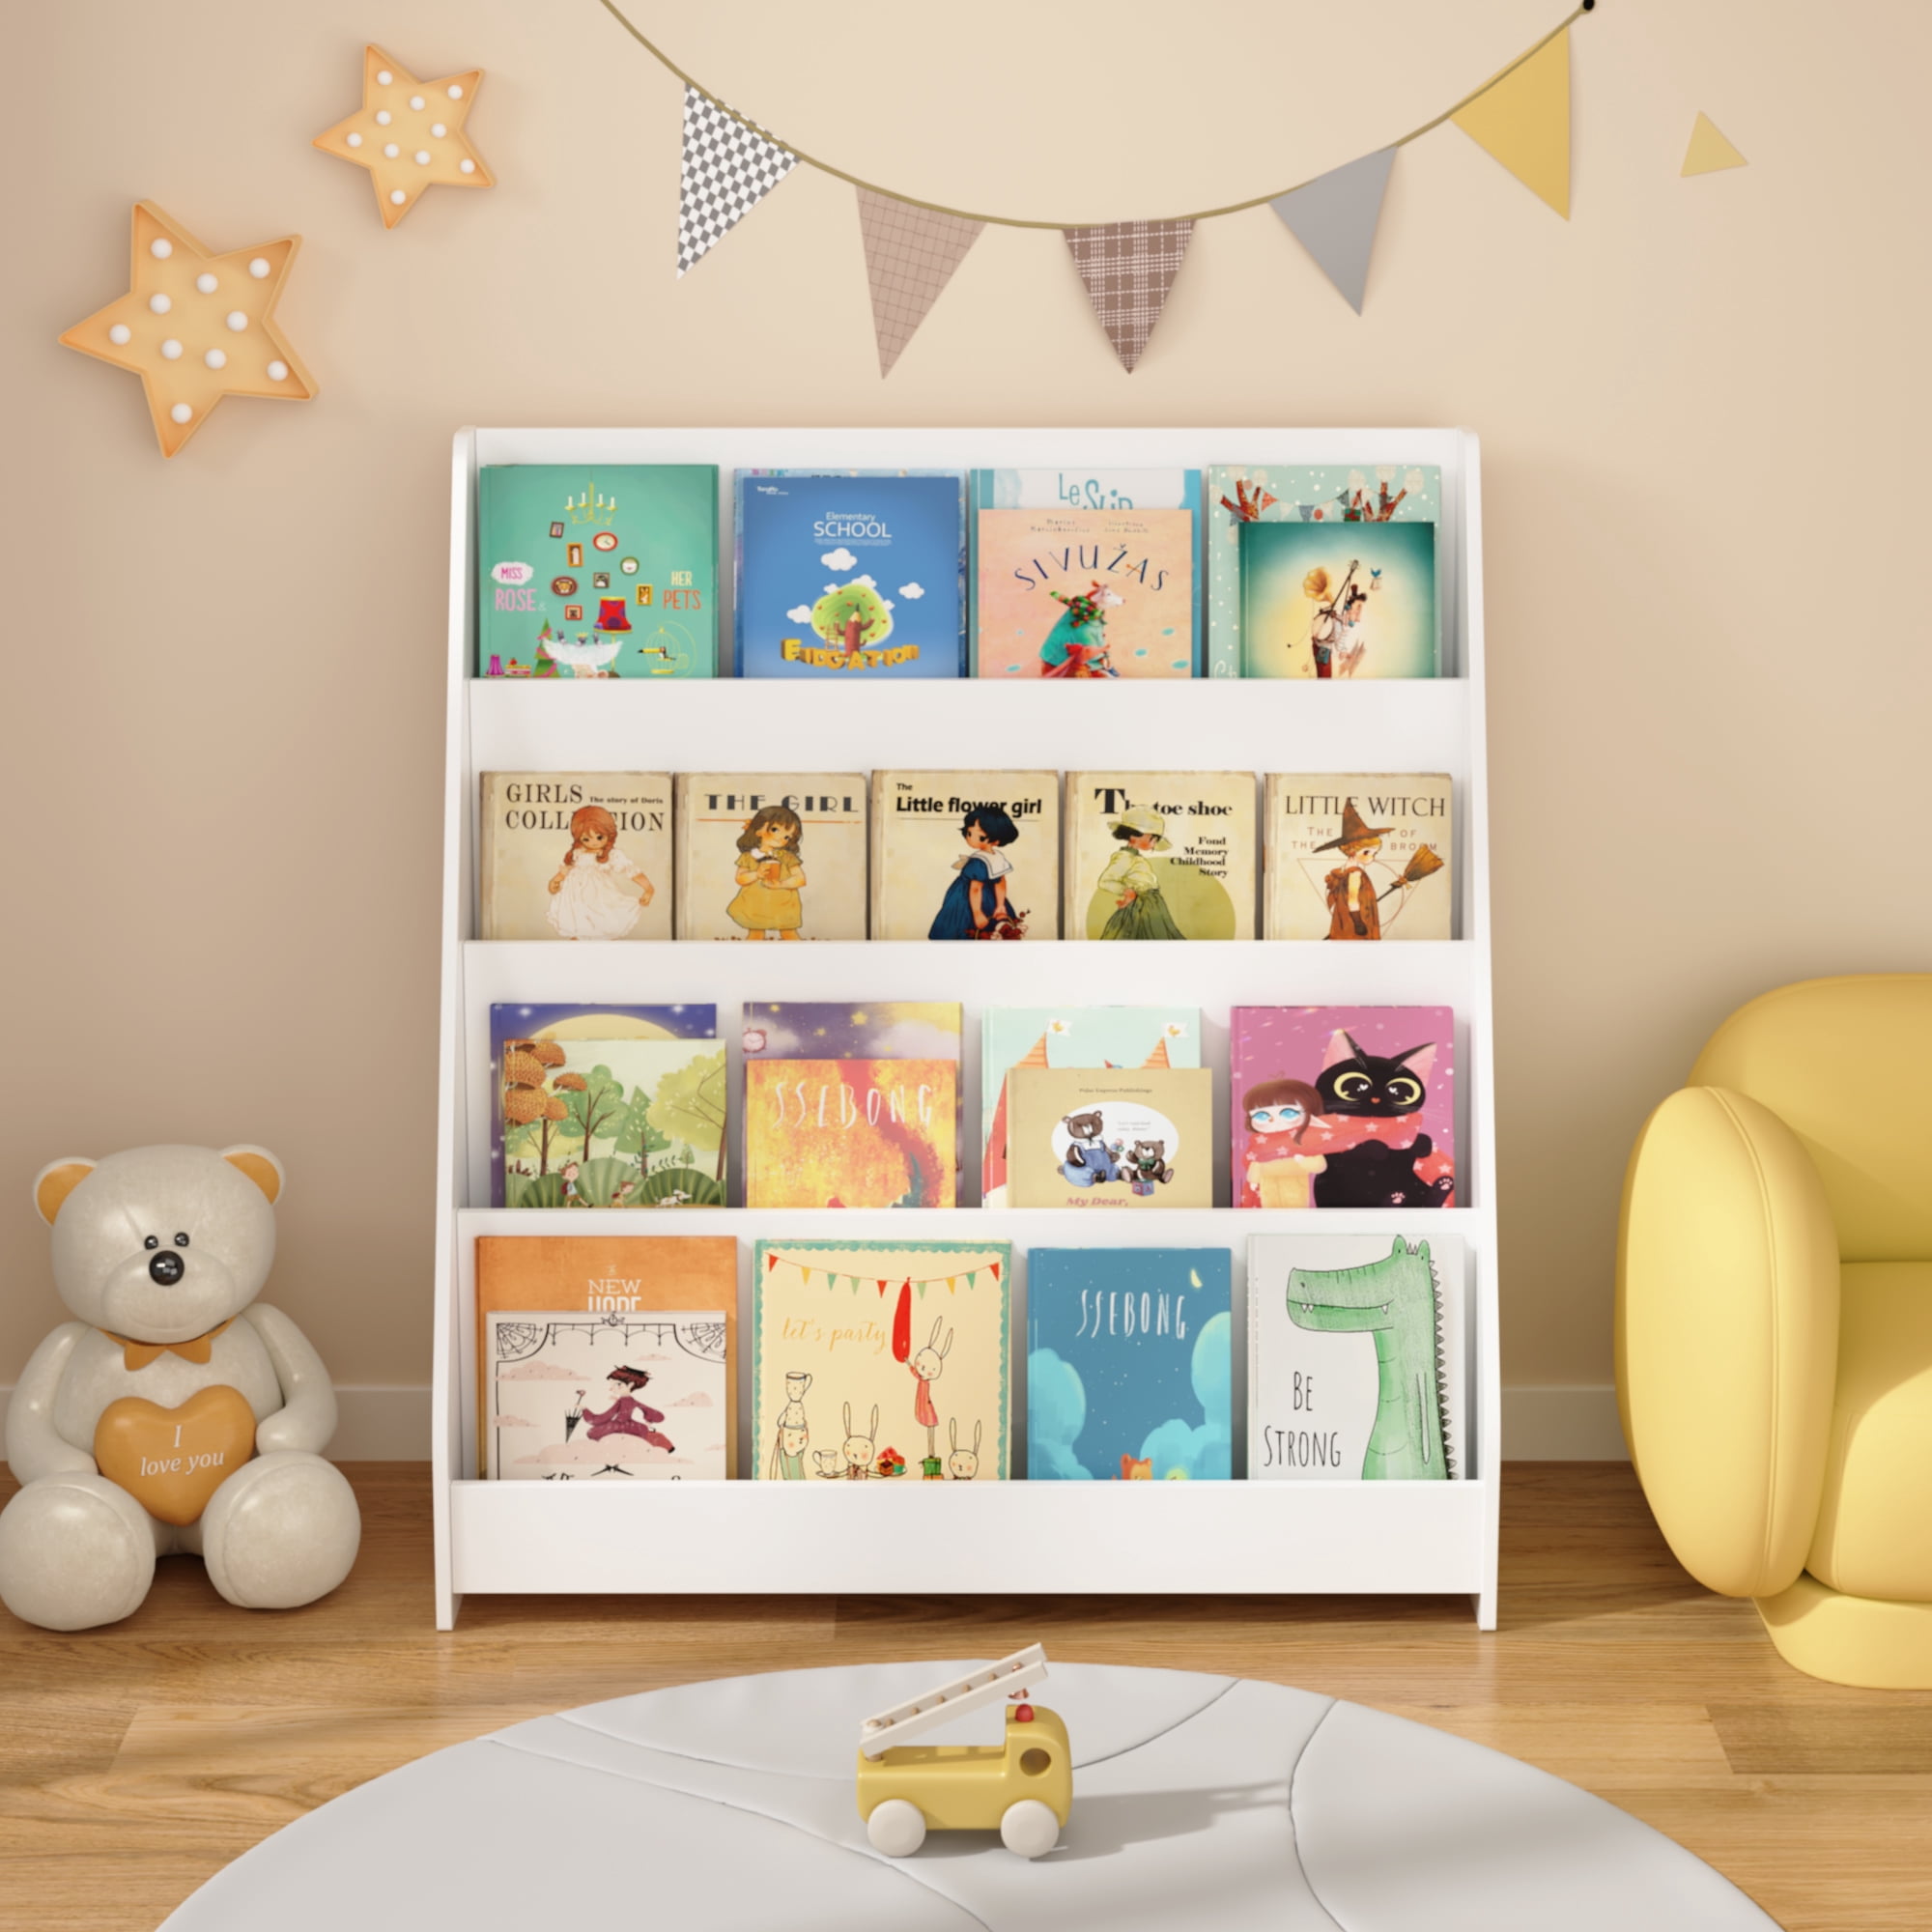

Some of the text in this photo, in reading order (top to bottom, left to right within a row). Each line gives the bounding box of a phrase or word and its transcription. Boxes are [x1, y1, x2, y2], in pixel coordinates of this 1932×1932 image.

[826, 511, 876, 523] Elementary
[813, 521, 893, 538] SCHOOL
[500, 567, 523, 581] MISS
[1014, 543, 1169, 591] SIVUŽAS
[671, 571, 693, 586] HER
[495, 588, 537, 611] ROSE
[663, 589, 701, 611] PETS
[506, 782, 583, 804] GIRLS
[896, 782, 913, 791] The
[704, 793, 859, 812] THE GIRL
[896, 796, 944, 812] Little
[1011, 798, 1042, 818] girl
[1187, 801, 1233, 816] shoe
[1368, 796, 1445, 817] WITCH
[505, 810, 665, 832] COLLION
[1198, 837, 1226, 845] Fond
[1307, 826, 1333, 838] THE
[1400, 829, 1417, 838] OF
[1184, 846, 1229, 856] Memory
[1292, 840, 1317, 850] THE
[1170, 857, 1226, 867] Childhood
[1198, 868, 1229, 878] Story
[1066, 1197, 1128, 1208] My Dear,
[587, 1278, 642, 1294] NEW
[1075, 1289, 1187, 1341] SSEBONG
[781, 1317, 887, 1356] let's party
[1293, 1370, 1313, 1411] BE
[173, 1424, 183, 1448] I
[1264, 1425, 1341, 1468] STRONG
[140, 1451, 224, 1477] love you
